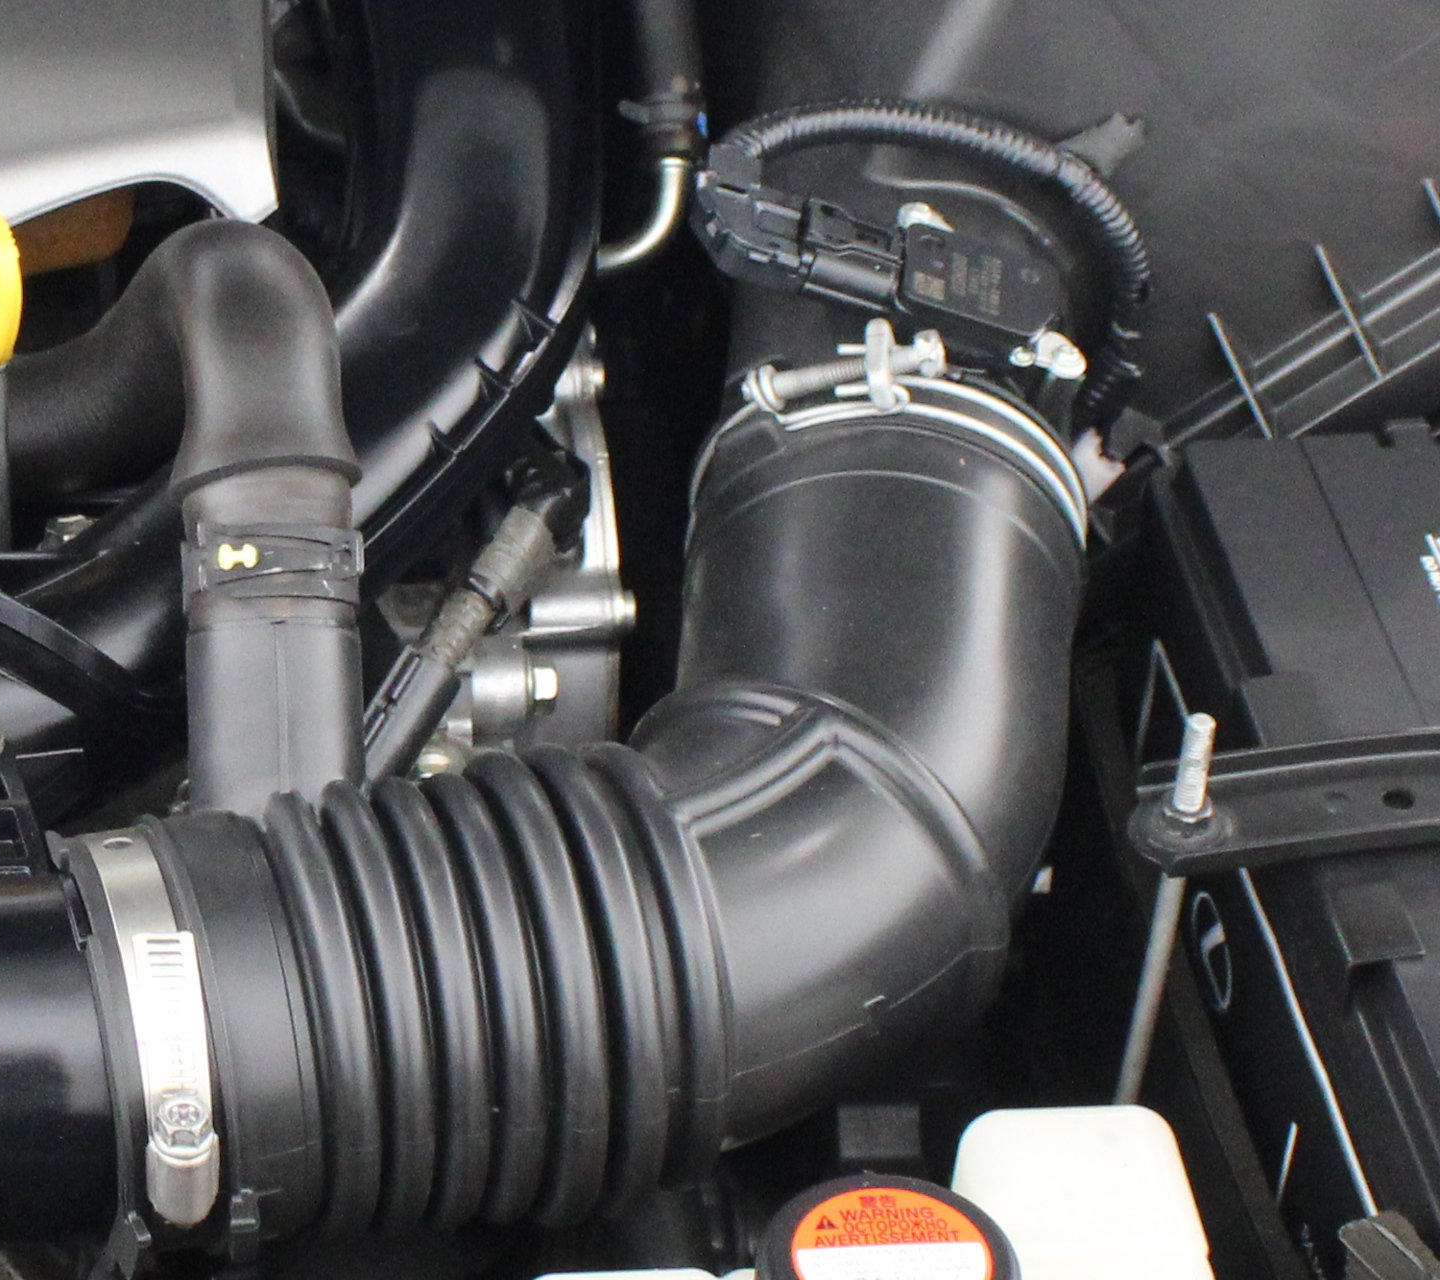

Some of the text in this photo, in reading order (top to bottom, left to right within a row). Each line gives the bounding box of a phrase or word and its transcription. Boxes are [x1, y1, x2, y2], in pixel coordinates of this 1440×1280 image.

[859, 1195, 897, 1208] 警告
[839, 1207, 934, 1221] WARNING
[842, 1218, 949, 1234] ОСТОРОЖНО
[813, 1230, 962, 1248] AVERTISSEMENT
